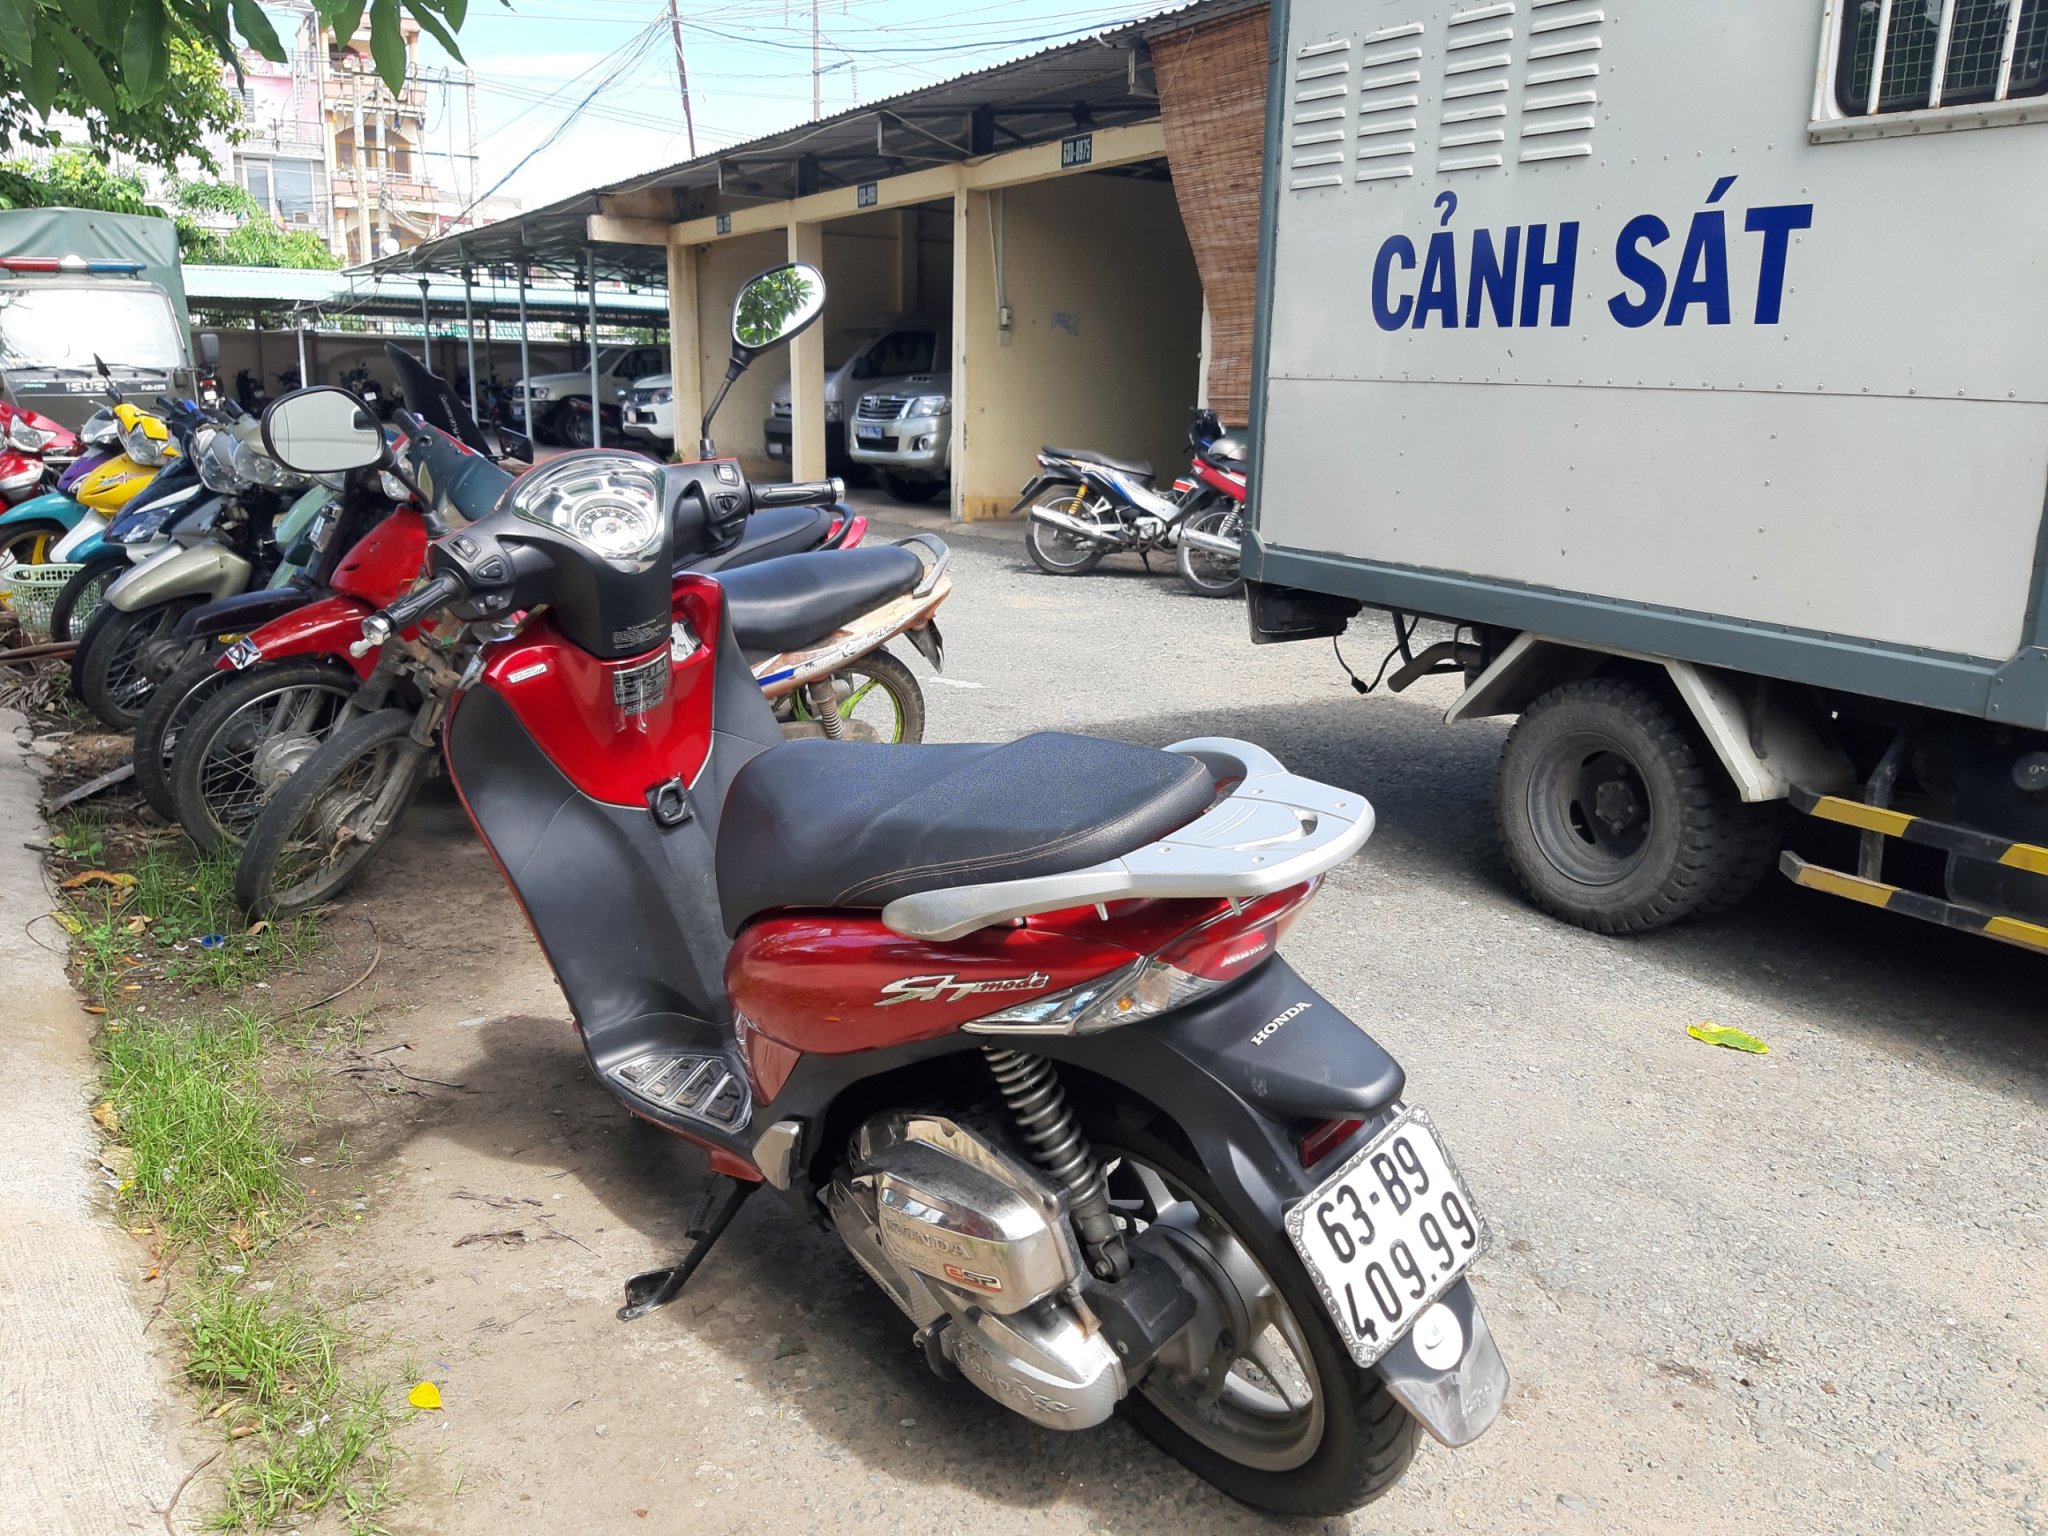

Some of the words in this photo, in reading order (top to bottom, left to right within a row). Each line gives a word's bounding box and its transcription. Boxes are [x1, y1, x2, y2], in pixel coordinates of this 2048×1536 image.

[1371, 190, 1580, 332] CẢNH
[1607, 175, 1814, 328] SÁT
[1249, 1001, 1313, 1048] HONDA
[885, 1219, 972, 1261] HONDA
[1316, 1136, 1430, 1264] 63-B9
[1344, 1191, 1476, 1343] 409.99
